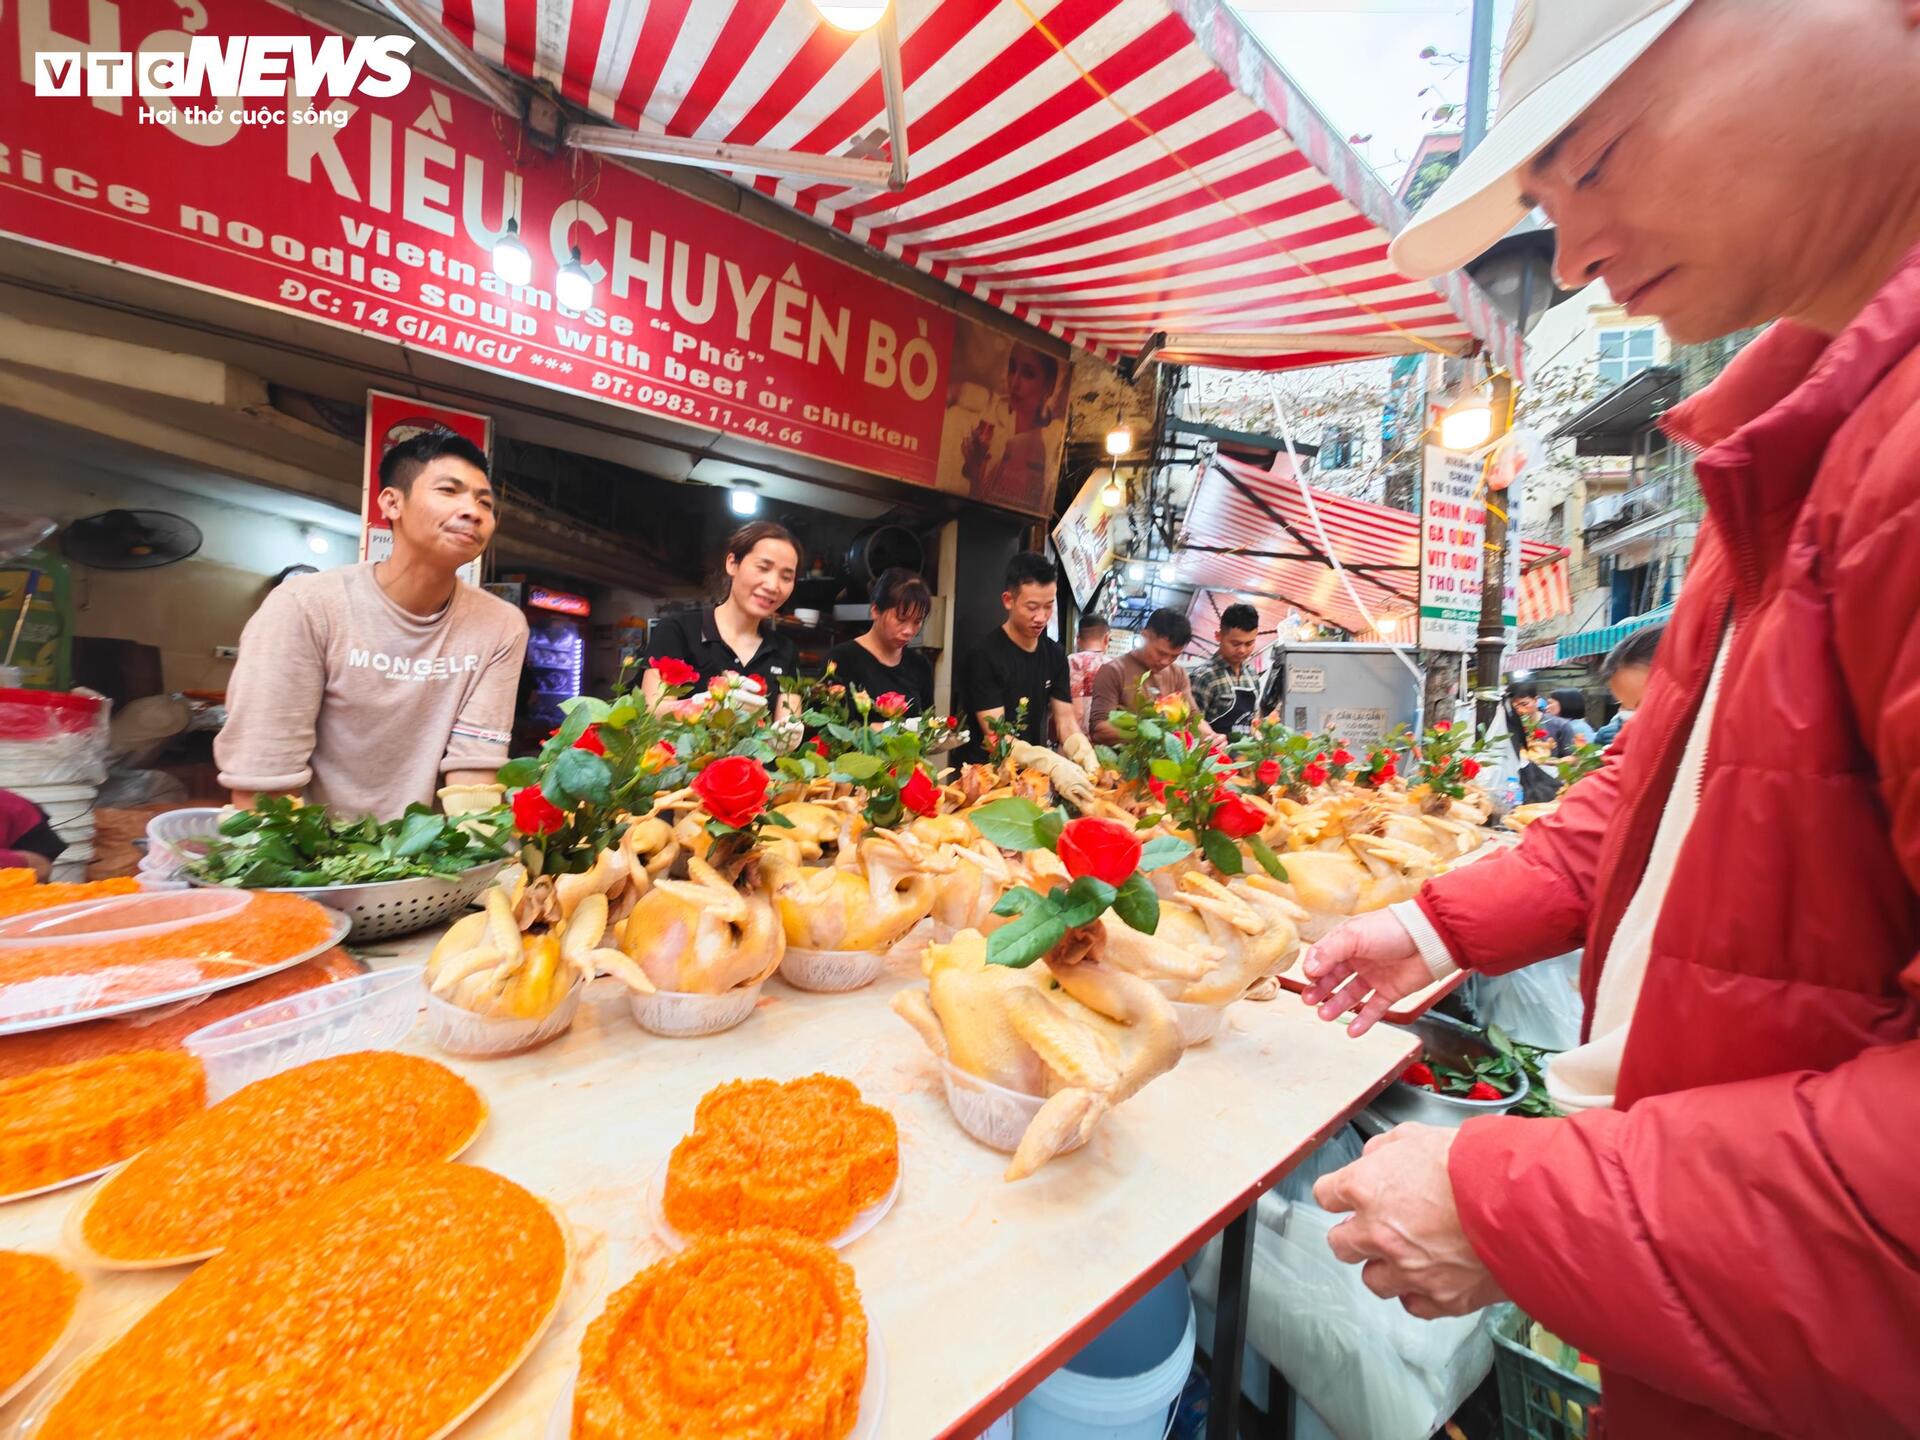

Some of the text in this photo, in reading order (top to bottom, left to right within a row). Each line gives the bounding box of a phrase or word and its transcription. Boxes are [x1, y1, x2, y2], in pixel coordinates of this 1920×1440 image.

[180, 204, 402, 293] noodle
[419, 283, 538, 336] soup
[554, 325, 650, 371] with
[664, 354, 750, 402] beef
[758, 388, 794, 414] or
[803, 402, 919, 452] chicken
[287, 78, 523, 252] KIỀU
[549, 199, 851, 375] CHUYÊN
[864, 318, 939, 401] BÒ
[340, 215, 634, 336] Vietnamese
[279, 278, 342, 314] ĐC:
[352, 301, 389, 328] 14
[396, 314, 448, 346] GIA
[453, 332, 523, 364] NGƯ
[591, 372, 634, 398] ĐT:
